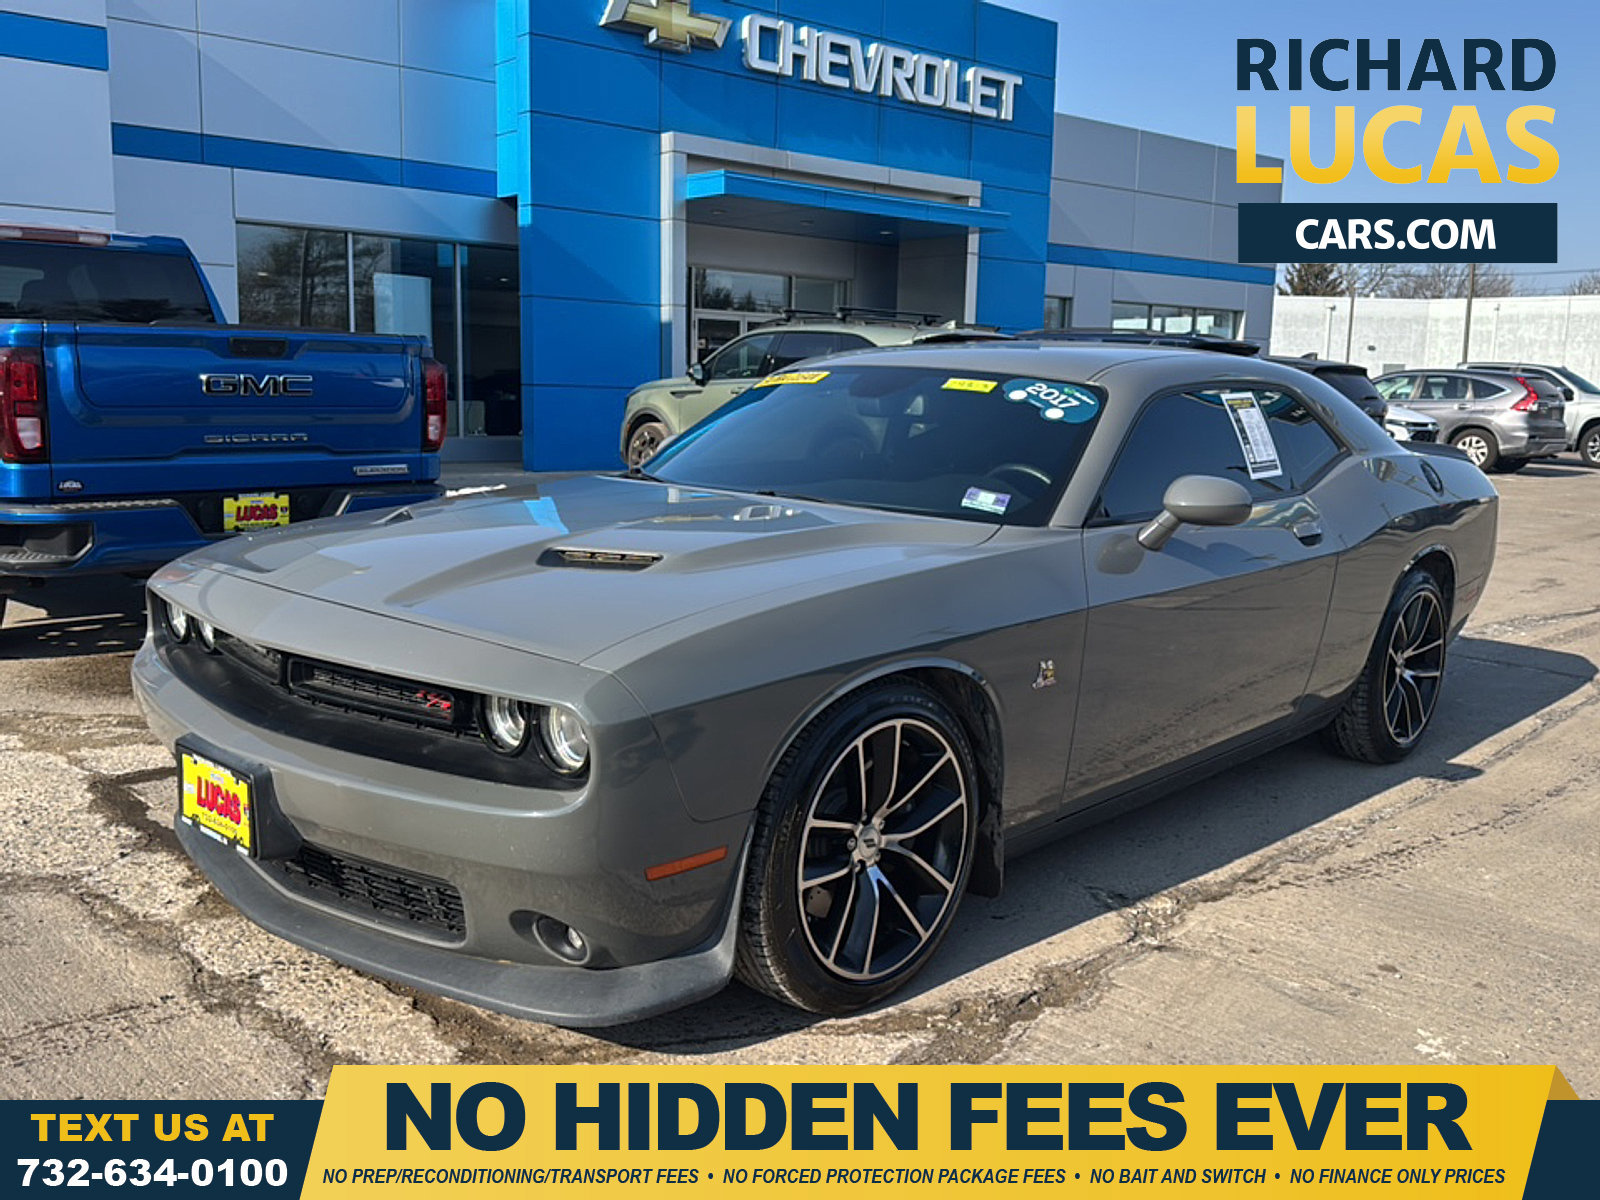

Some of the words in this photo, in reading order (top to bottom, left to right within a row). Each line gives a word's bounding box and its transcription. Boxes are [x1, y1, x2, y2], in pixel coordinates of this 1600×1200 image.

[742, 13, 1022, 121] CHEVROLET
[200, 373, 313, 397] GMC
[1025, 383, 1081, 408] 2017
[204, 432, 309, 444] SIERRA
[236, 503, 278, 522] LUCAS
[196, 776, 241, 825] LUCAS
